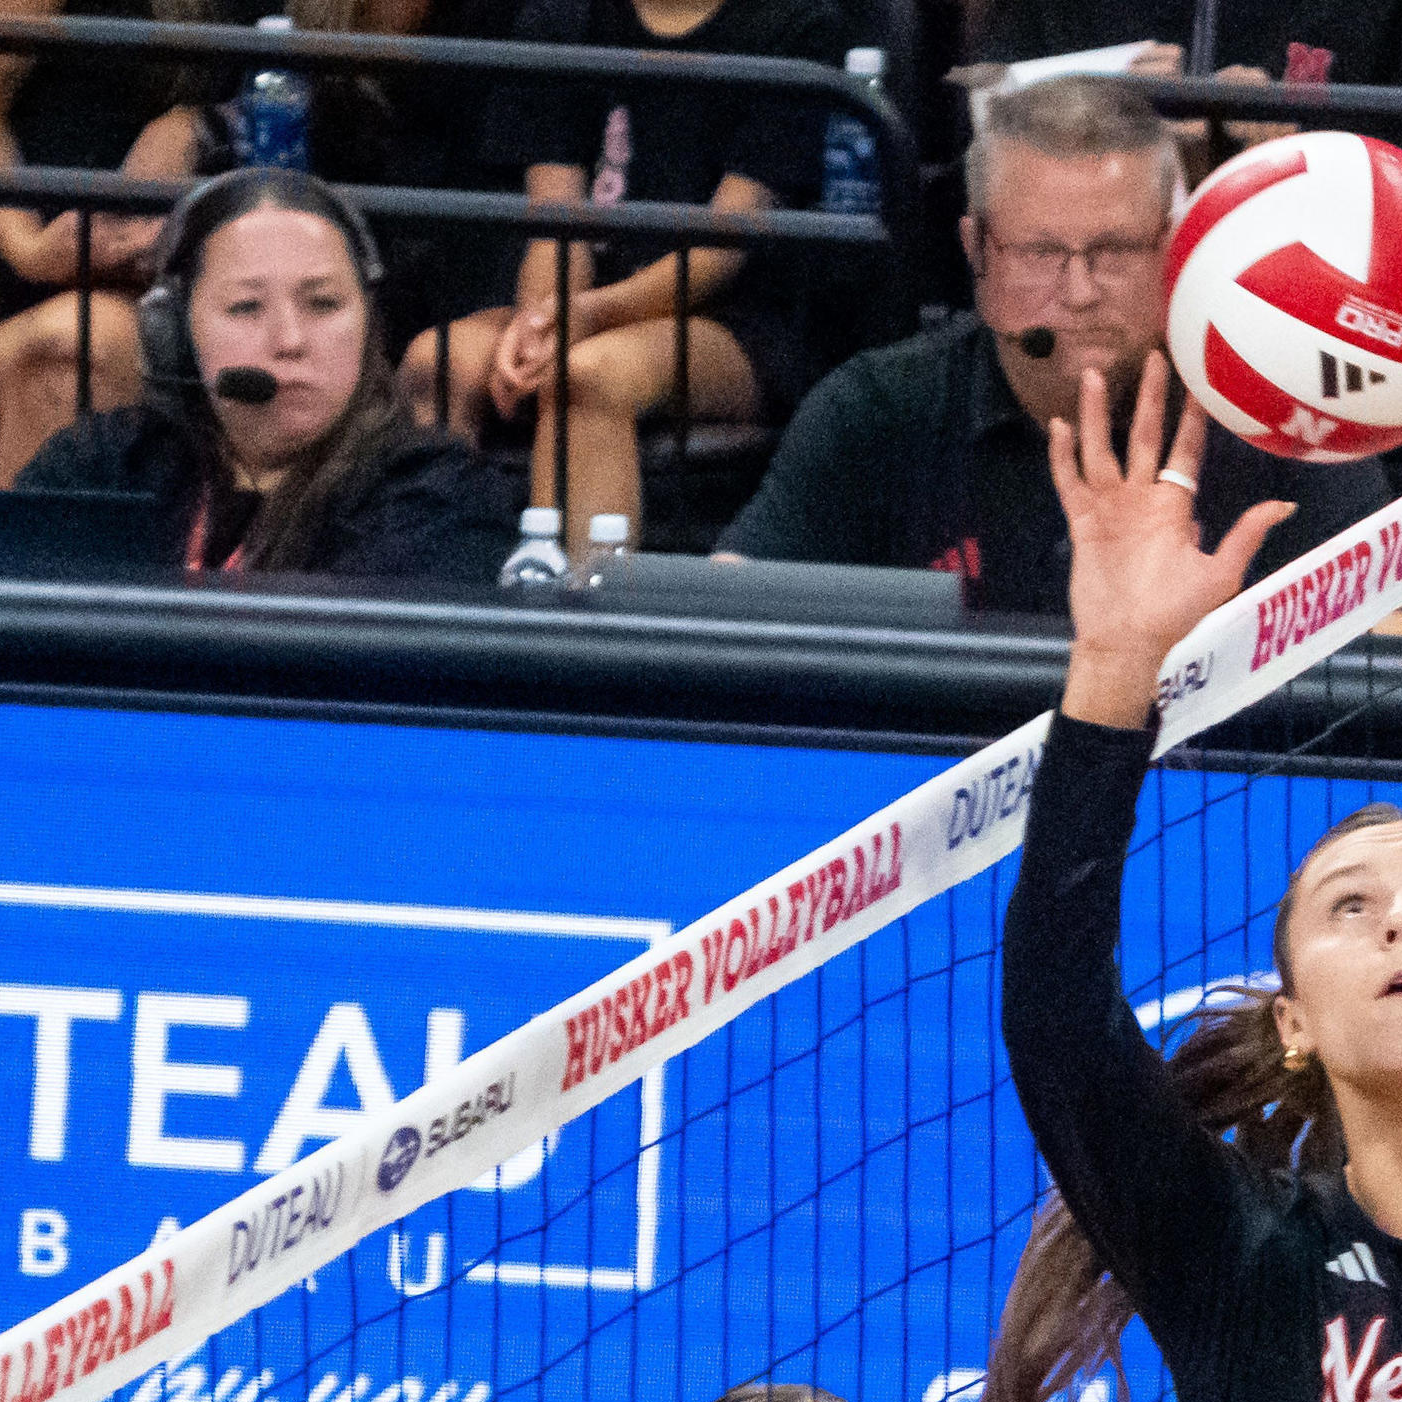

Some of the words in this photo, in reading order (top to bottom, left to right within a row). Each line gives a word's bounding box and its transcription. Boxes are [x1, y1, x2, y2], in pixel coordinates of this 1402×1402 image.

[1250, 540, 1371, 672] HUSKER
[948, 742, 1045, 850] DUTEA
[561, 949, 694, 1092] HUSKER
[701, 822, 902, 1005] VOLLEYBALL
[228, 1160, 345, 1285] DUTEAU
[425, 1071, 517, 1158] SUBARU
